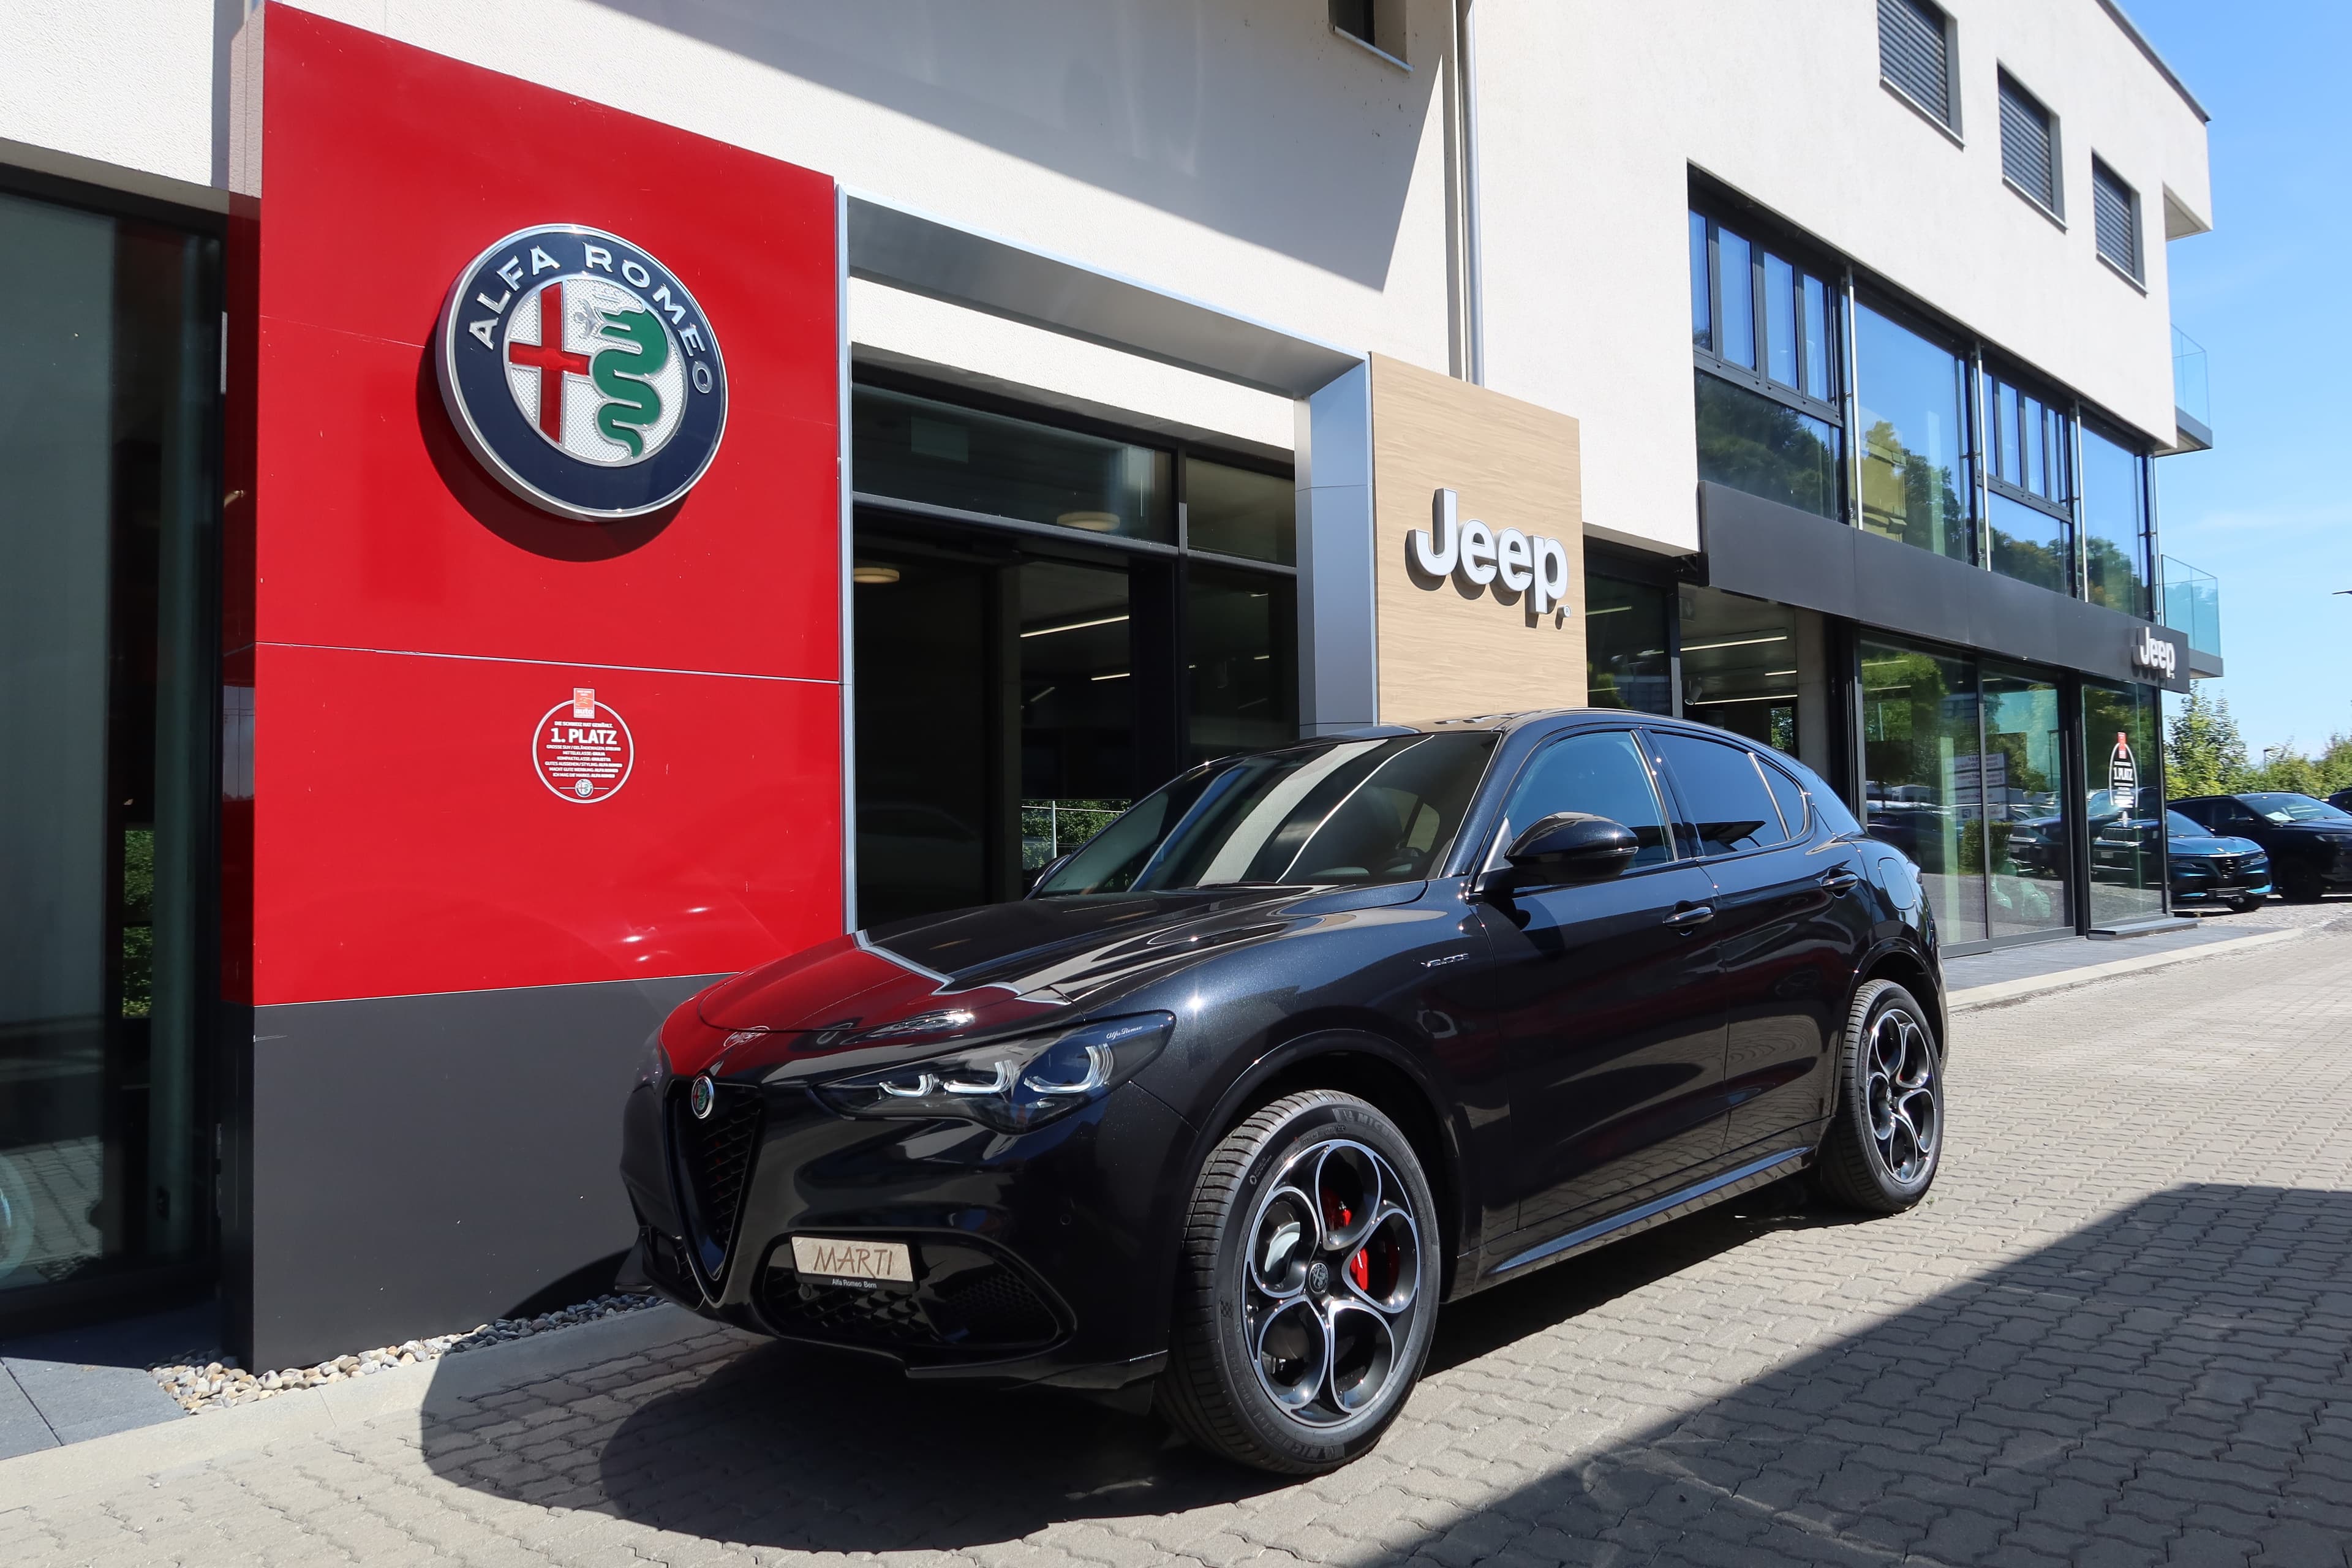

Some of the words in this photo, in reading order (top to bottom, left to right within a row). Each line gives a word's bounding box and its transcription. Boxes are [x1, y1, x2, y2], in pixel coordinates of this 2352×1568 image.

[469, 245, 560, 350] ALFA
[583, 241, 712, 394] ROMEO
[1412, 488, 1569, 614] Jeep
[2138, 626, 2176, 678] Jeep
[551, 728, 566, 742] 1.
[568, 728, 617, 745] PLATZ
[1121, 1025, 1143, 1035] Romeo
[813, 1246, 893, 1279] MARTI
[843, 1279, 862, 1287] Romeo
[864, 1280, 877, 1289] Bern
